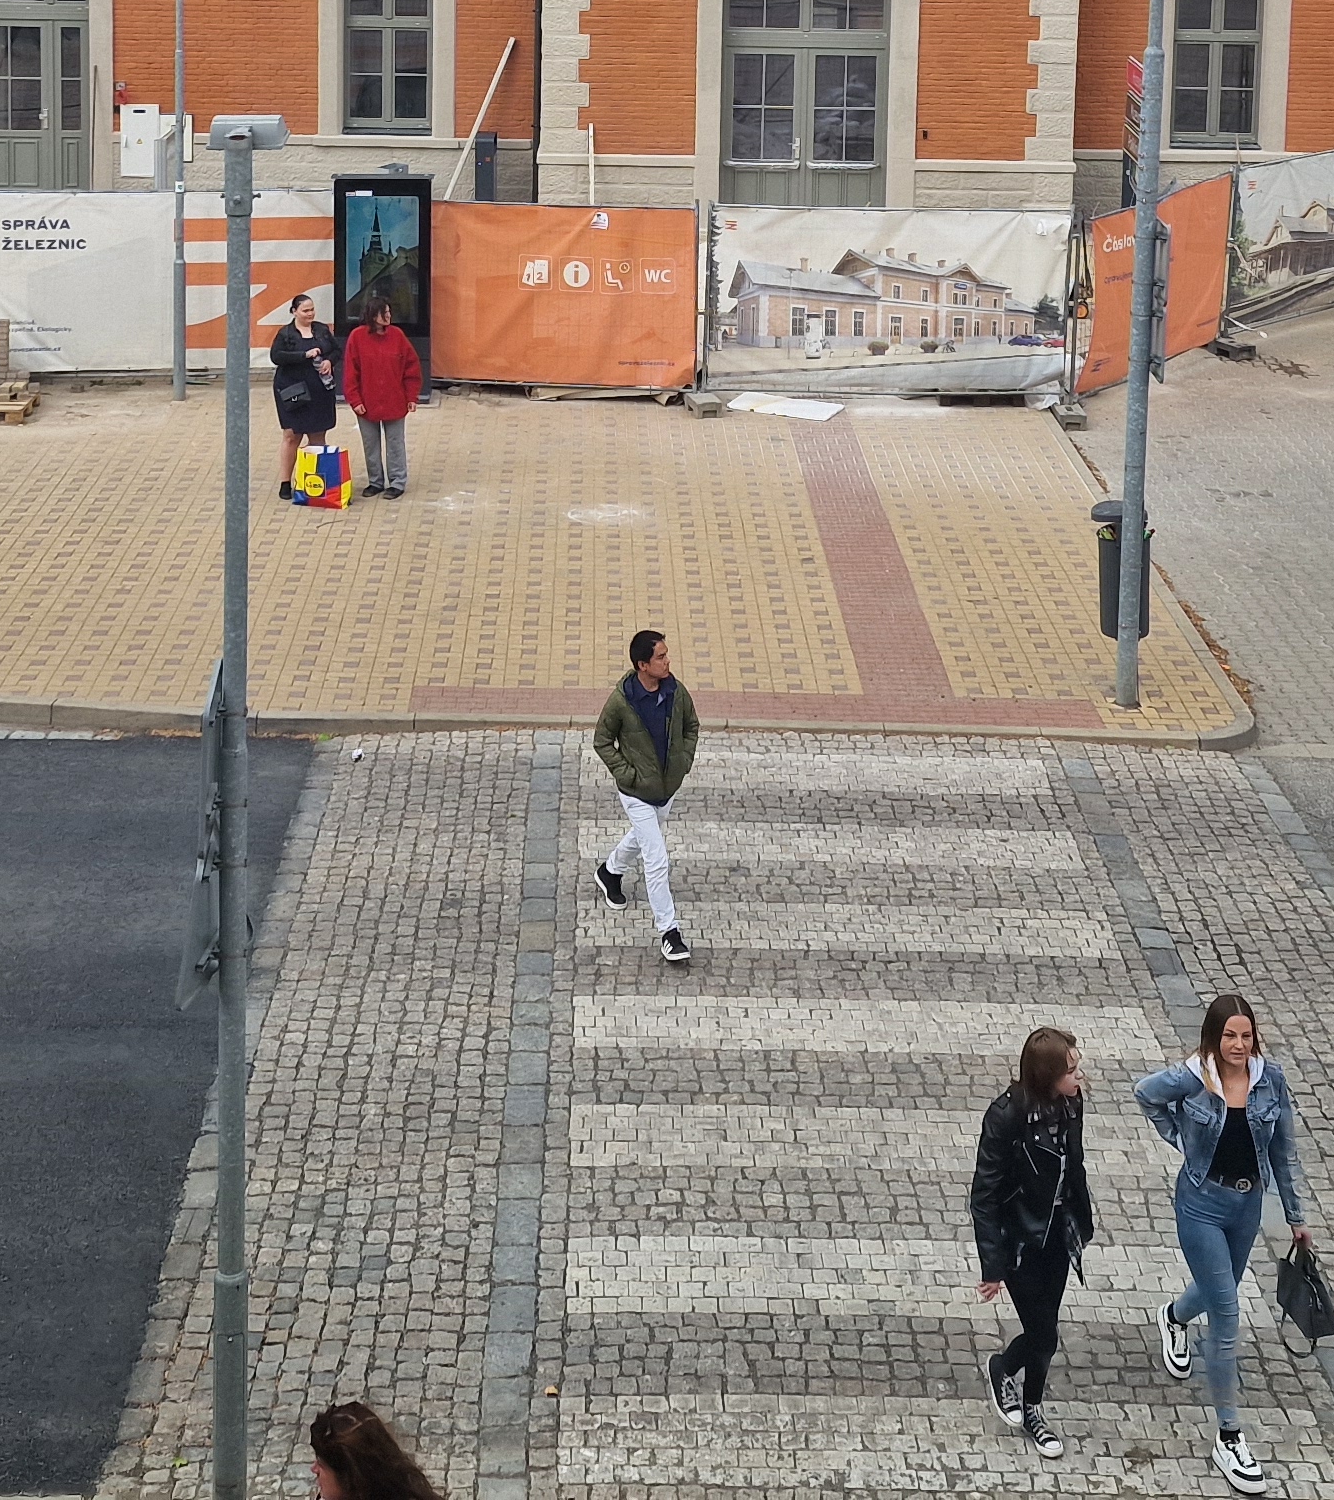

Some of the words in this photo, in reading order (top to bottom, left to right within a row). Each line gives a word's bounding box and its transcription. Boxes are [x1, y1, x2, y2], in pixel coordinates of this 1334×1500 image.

[1, 216, 71, 231] SPRÁVA
[1, 237, 87, 250] ŽELEZNIC
[644, 269, 671, 283] WC
